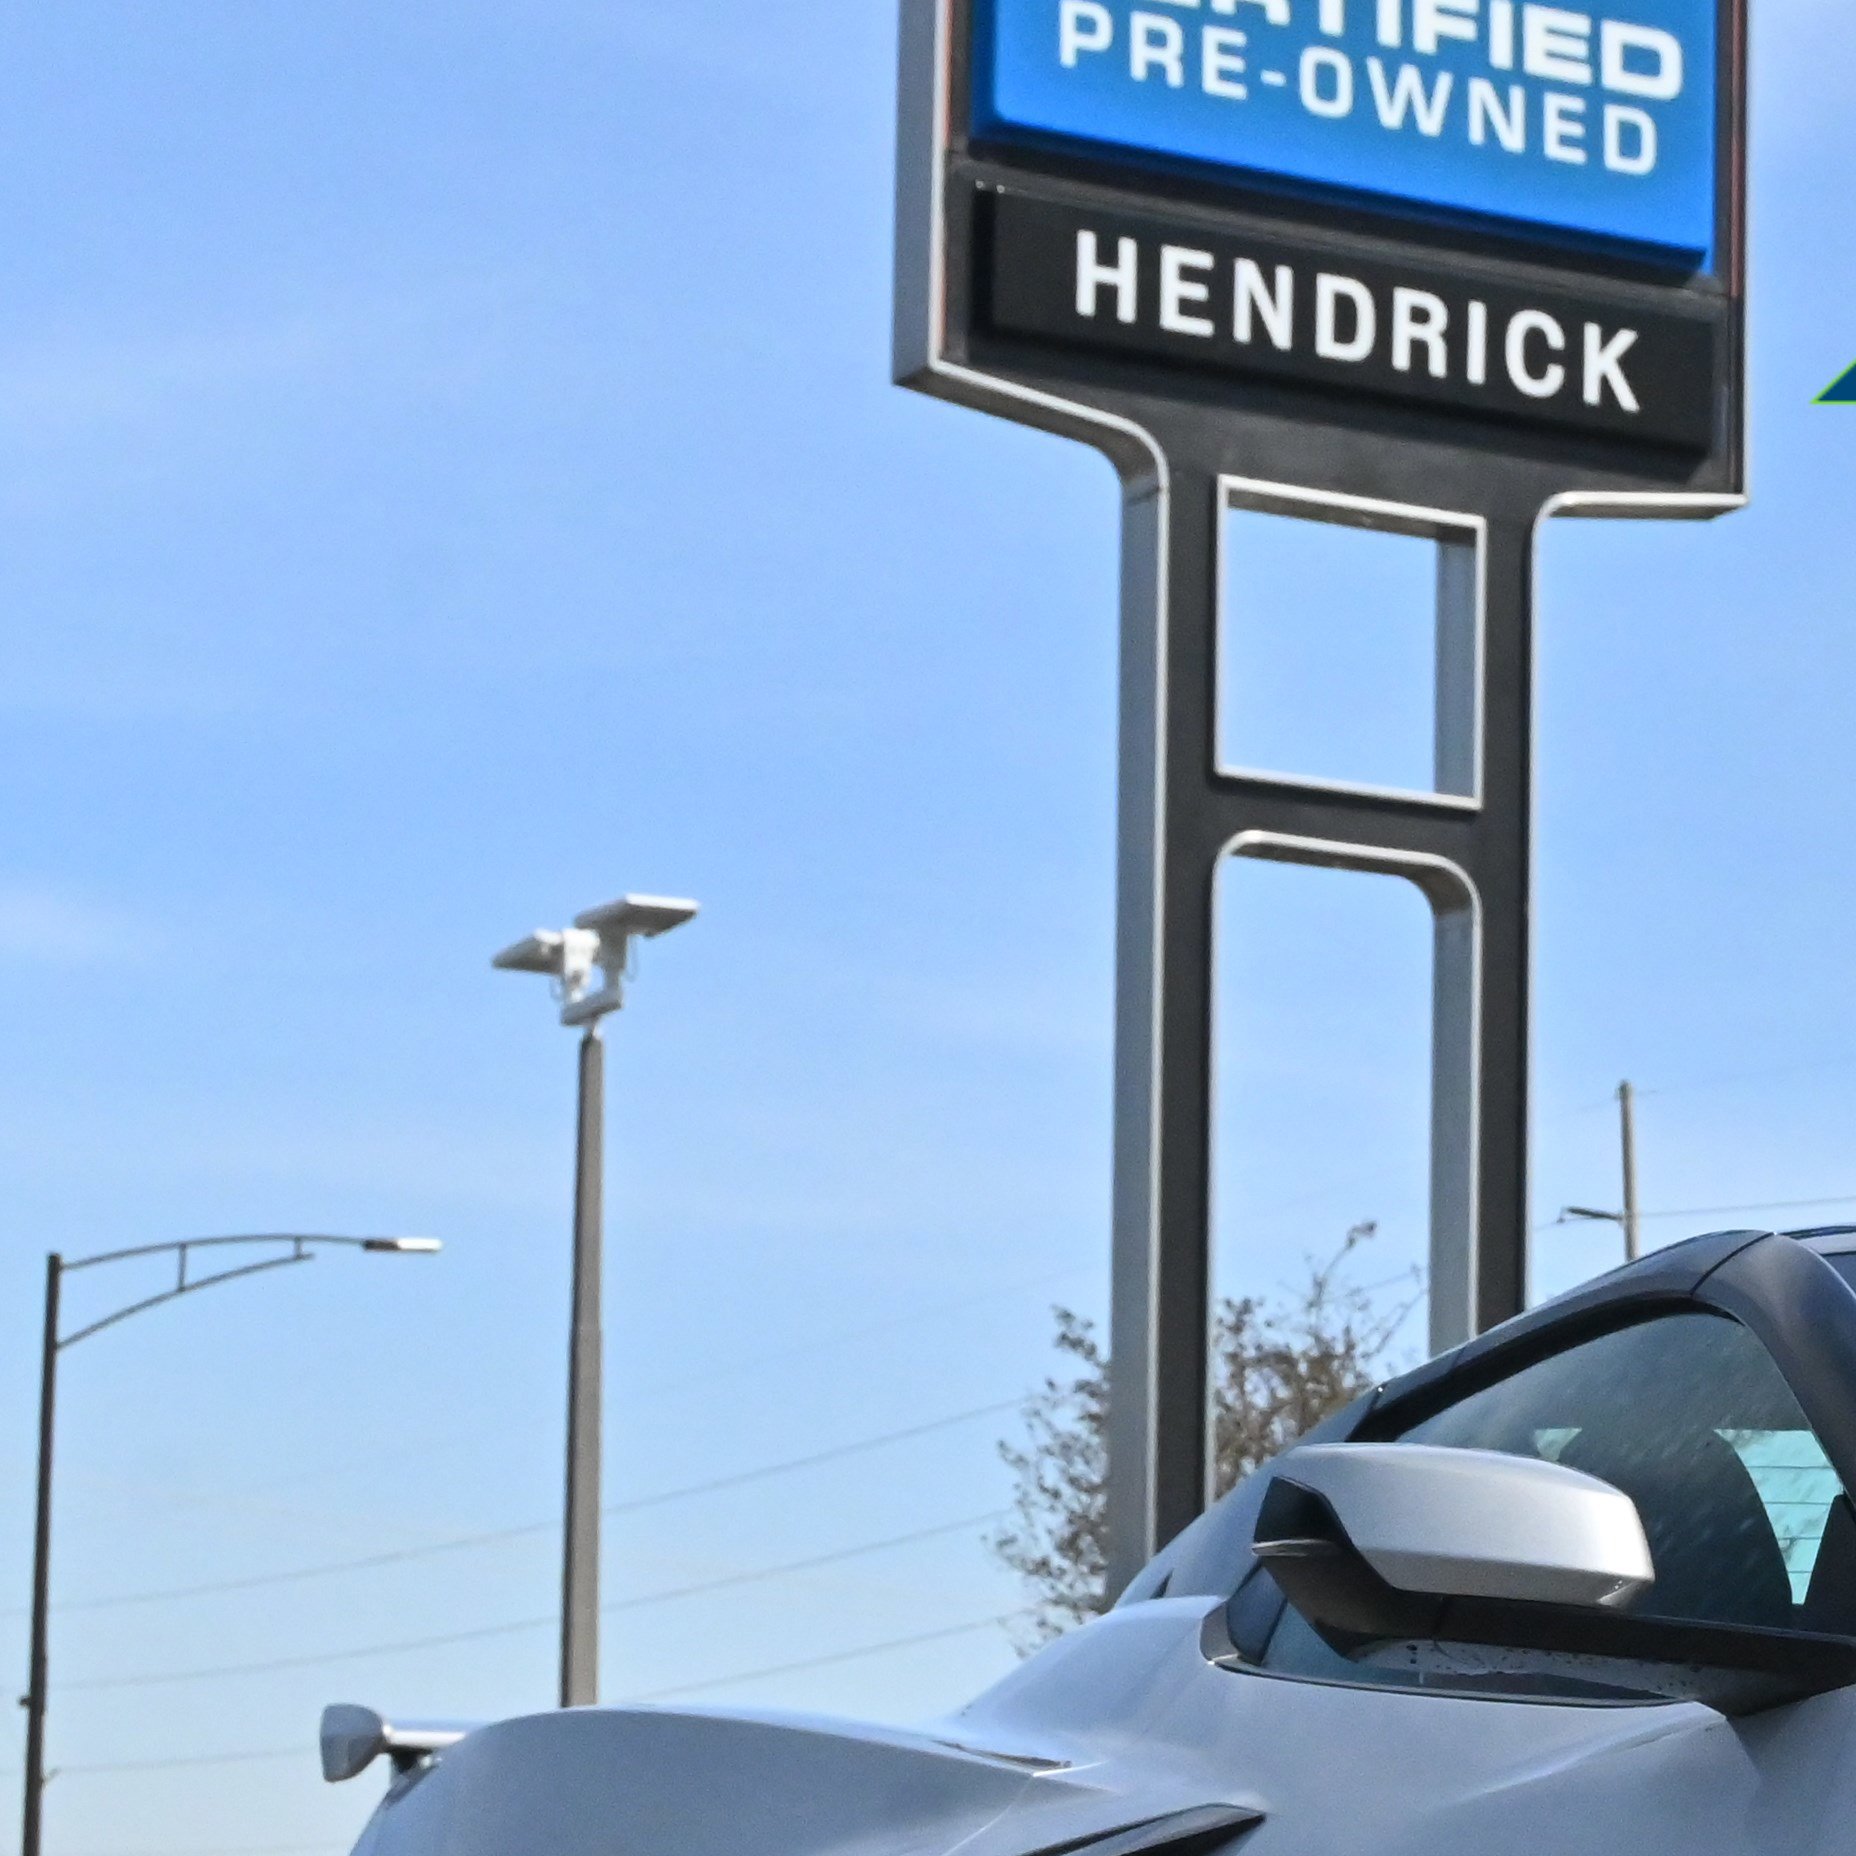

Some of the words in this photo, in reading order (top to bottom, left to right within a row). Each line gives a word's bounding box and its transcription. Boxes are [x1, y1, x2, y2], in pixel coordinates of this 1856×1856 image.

[1058, 2, 1658, 177] PRE-OWNED
[1166, 0, 1684, 100] IFIED
[1074, 229, 1640, 413] HENDRICK
